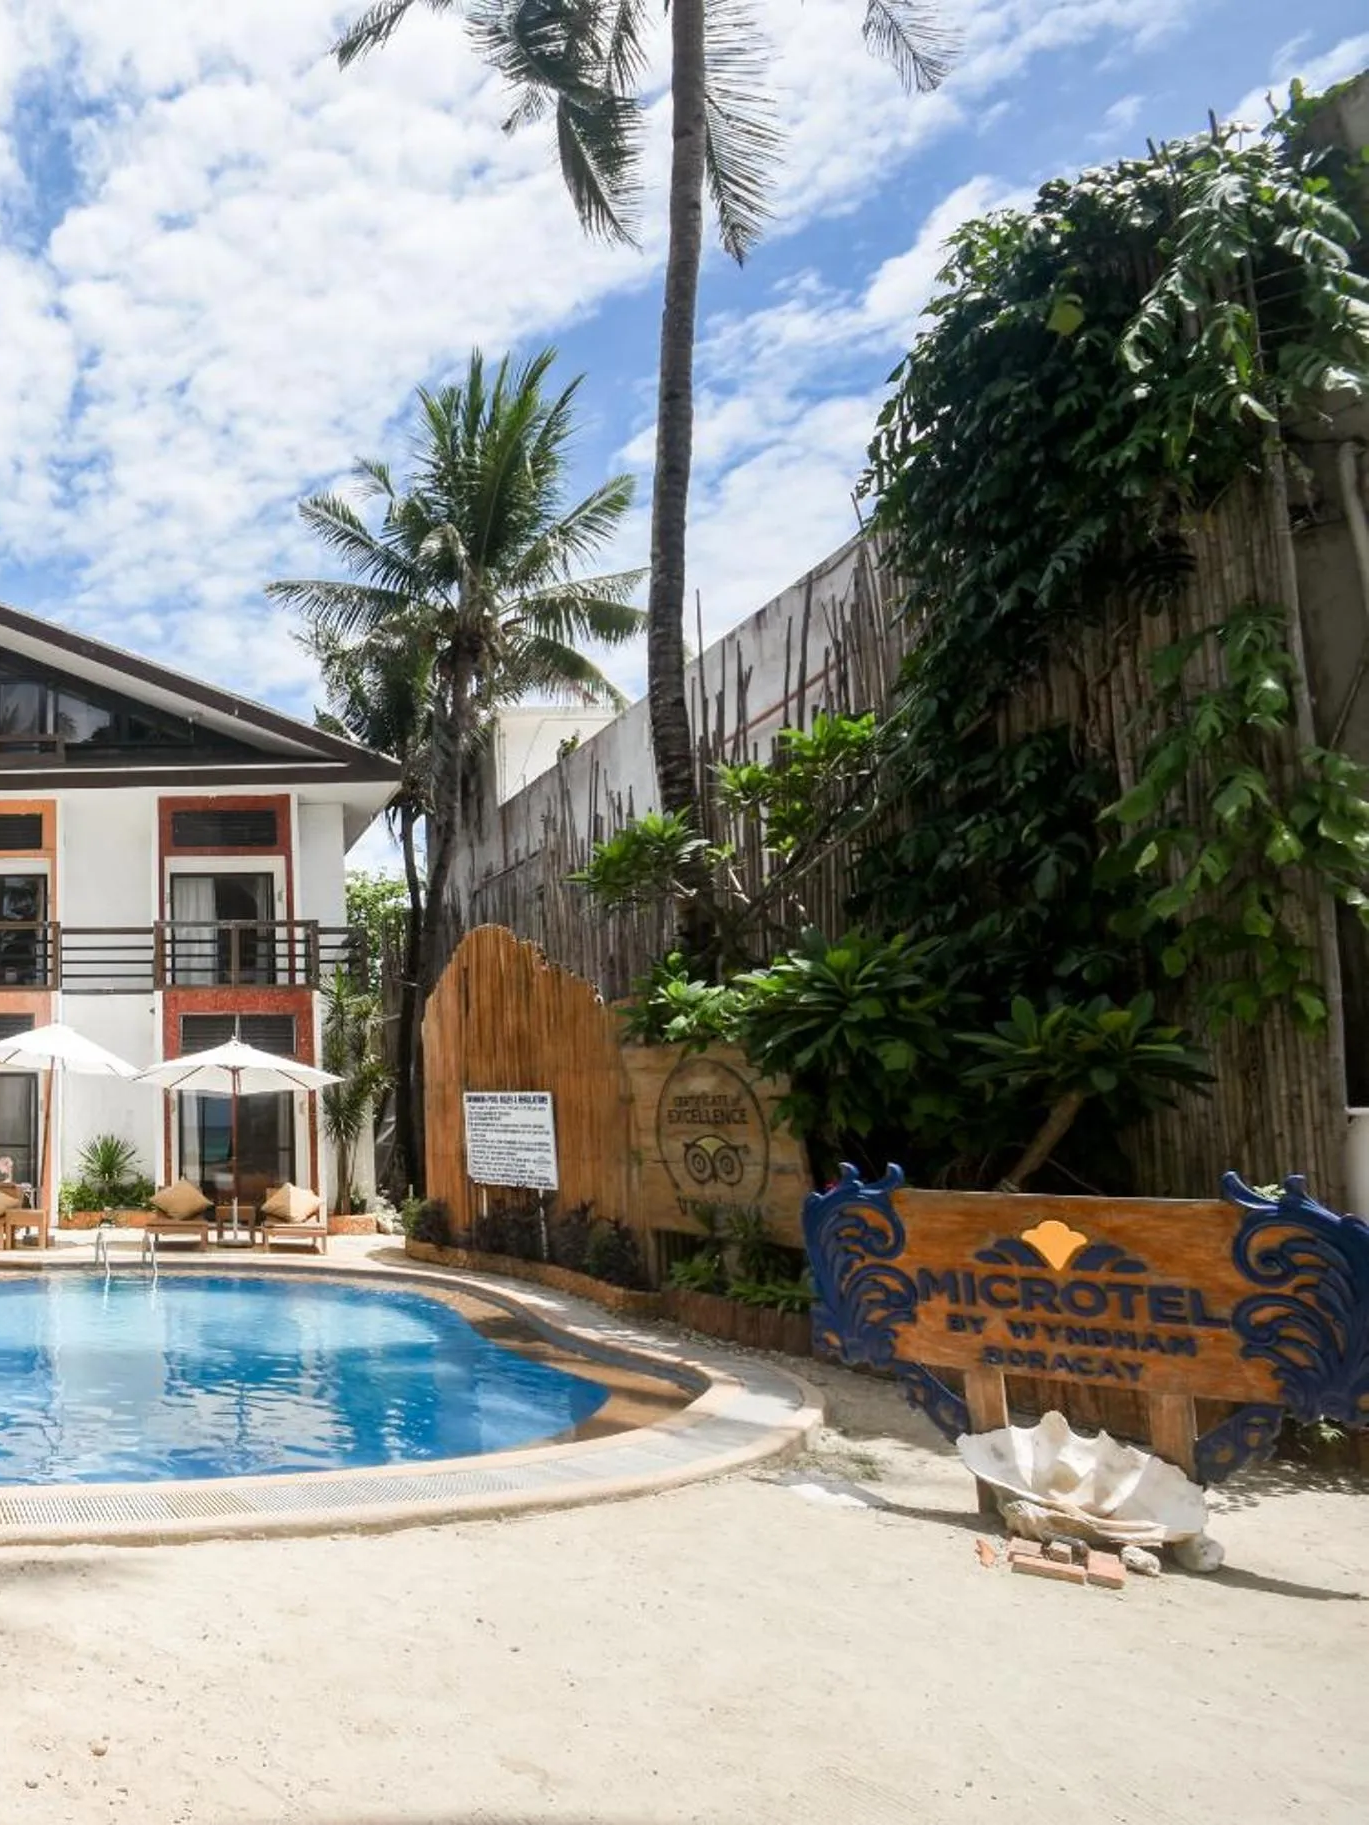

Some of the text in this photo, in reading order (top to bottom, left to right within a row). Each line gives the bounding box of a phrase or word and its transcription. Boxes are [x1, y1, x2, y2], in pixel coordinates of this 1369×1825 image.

[667, 1109, 748, 1125] EXCELLENCE
[916, 1268, 1231, 1328] MICROTEL
[948, 1314, 1197, 1357] BY WYNDHAM
[983, 1347, 1144, 1380] BORACAY
